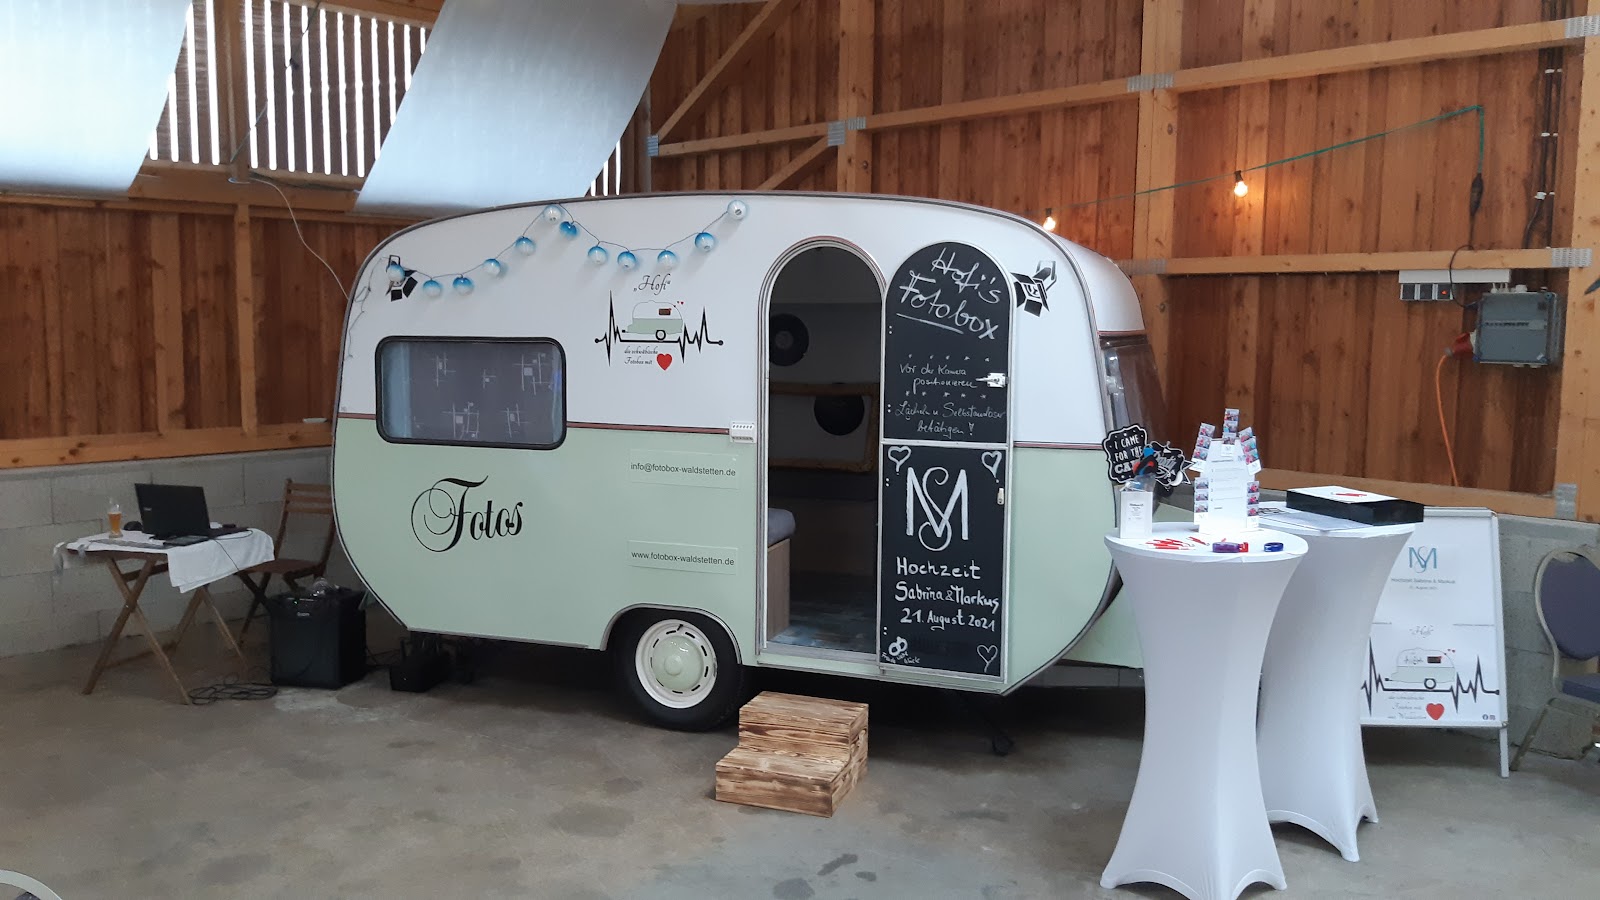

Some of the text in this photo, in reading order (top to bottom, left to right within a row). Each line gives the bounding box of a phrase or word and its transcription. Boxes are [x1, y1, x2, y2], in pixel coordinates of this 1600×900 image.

[899, 270, 999, 340] Fotobox
[900, 363, 966, 375] Vor der Kamera
[912, 377, 978, 394] positionieren
[1114, 434, 1140, 450] I CAME
[1114, 445, 1143, 462] FOR THE
[630, 462, 736, 477] info@fotobox-waldstetten.de
[411, 475, 523, 552] Fotos
[631, 551, 735, 566] www.fotobox-waldstetten.de
[896, 556, 981, 580] Hochzeit
[895, 580, 944, 602] Sabrina
[951, 584, 1000, 614] Markus
[900, 607, 995, 632] 21. August 2021
